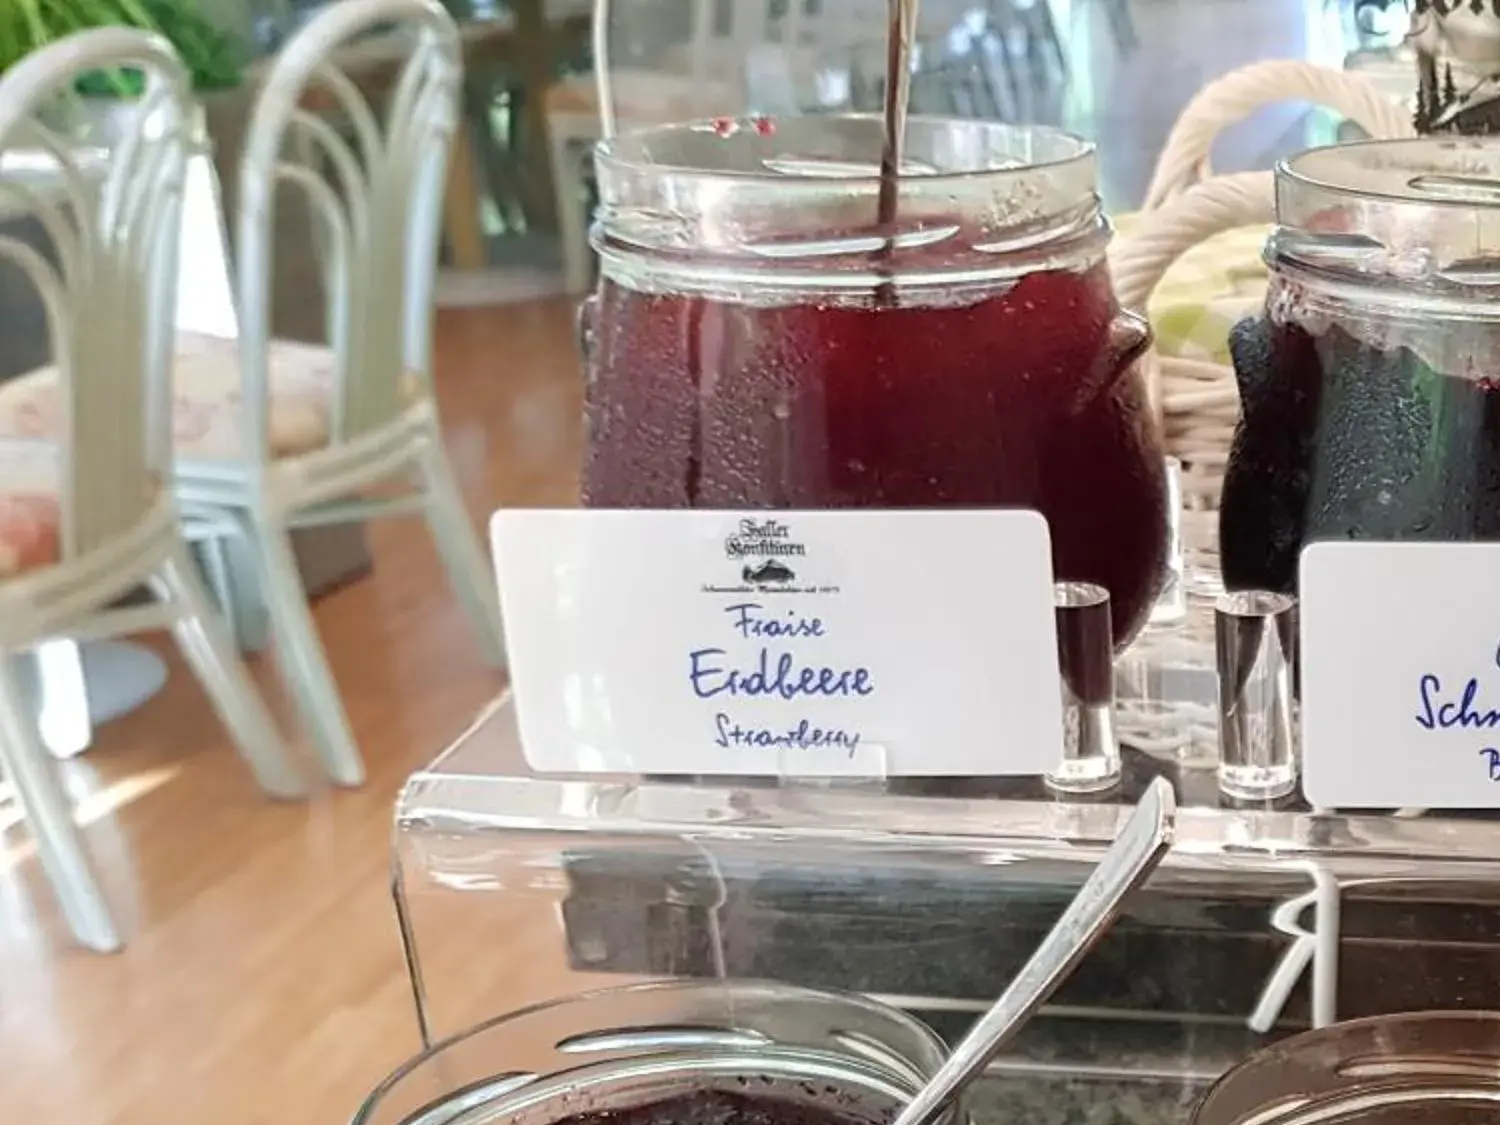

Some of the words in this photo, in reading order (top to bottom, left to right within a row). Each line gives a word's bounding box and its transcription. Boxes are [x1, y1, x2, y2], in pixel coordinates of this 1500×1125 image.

[723, 602, 826, 639] Fraise
[688, 646, 875, 701] Erdbeere
[714, 712, 861, 760] Strawberry
